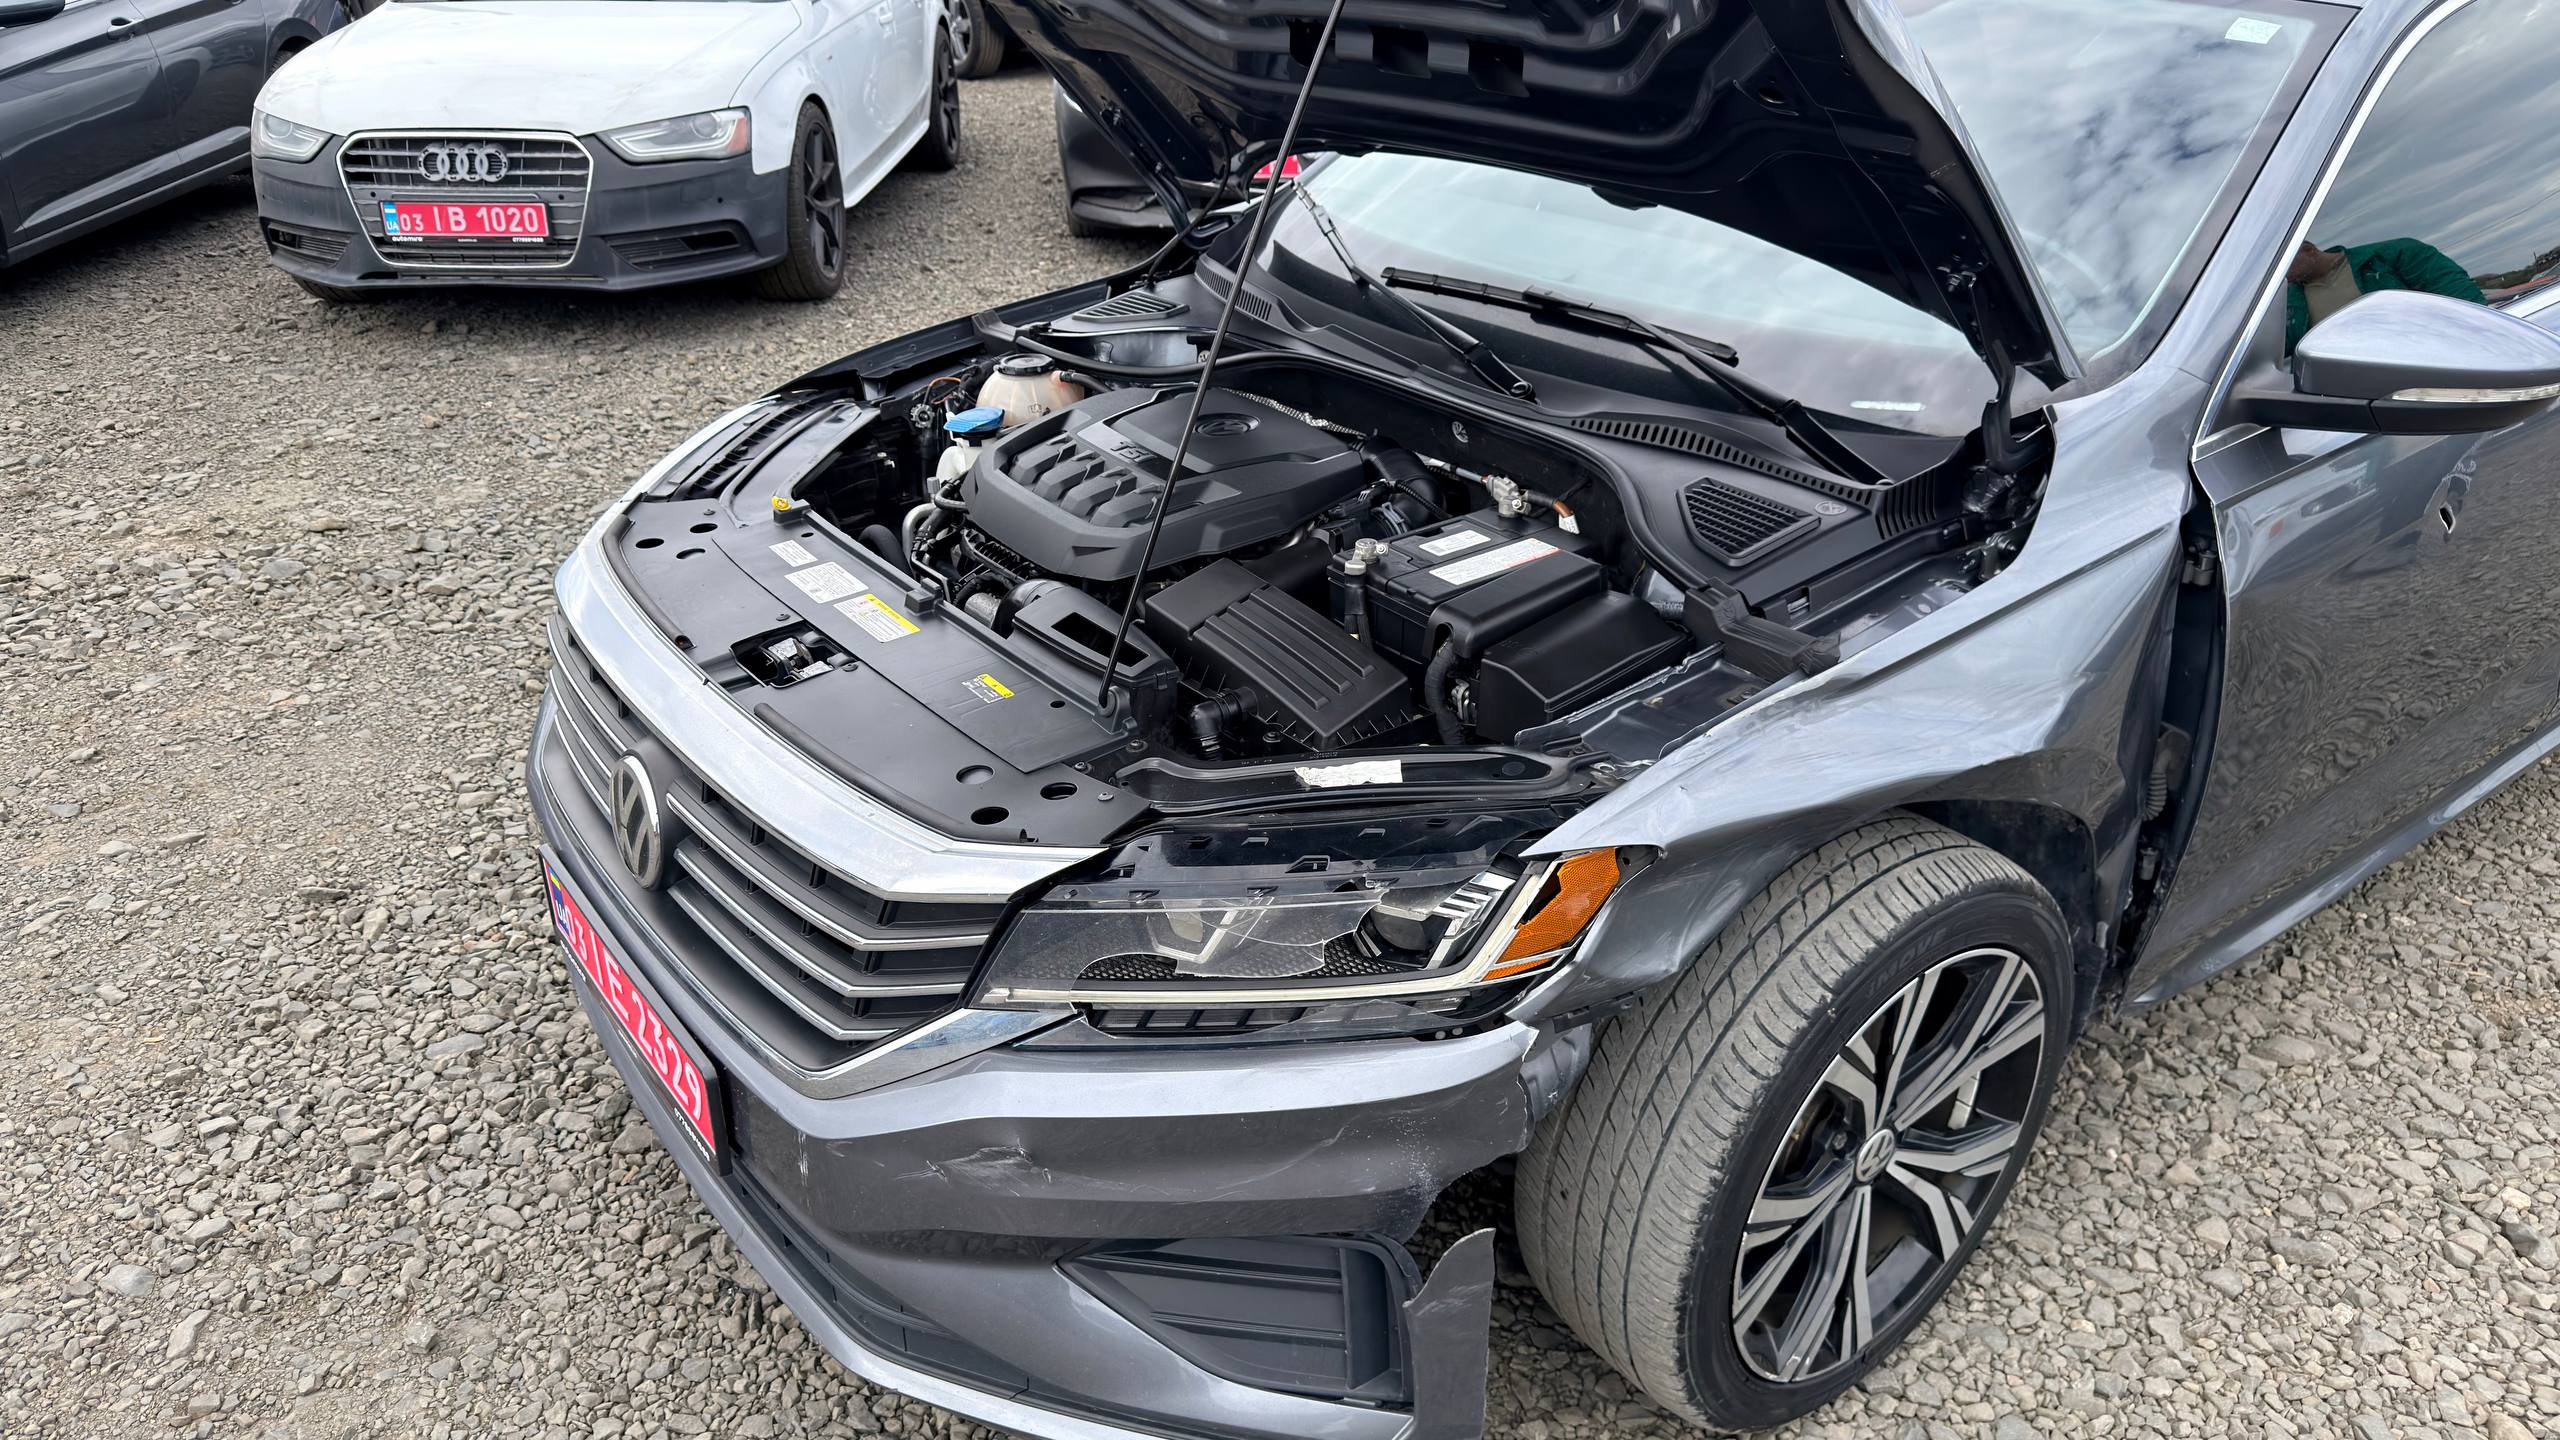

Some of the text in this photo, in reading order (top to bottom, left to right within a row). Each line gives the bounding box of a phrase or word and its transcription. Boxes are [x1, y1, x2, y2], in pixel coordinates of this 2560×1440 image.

[386, 221, 399, 231] UA
[400, 206, 539, 233] 03 IB 1020
[565, 905, 588, 962] 03
[589, 929, 630, 1022] IE
[631, 989, 702, 1121] 2329
